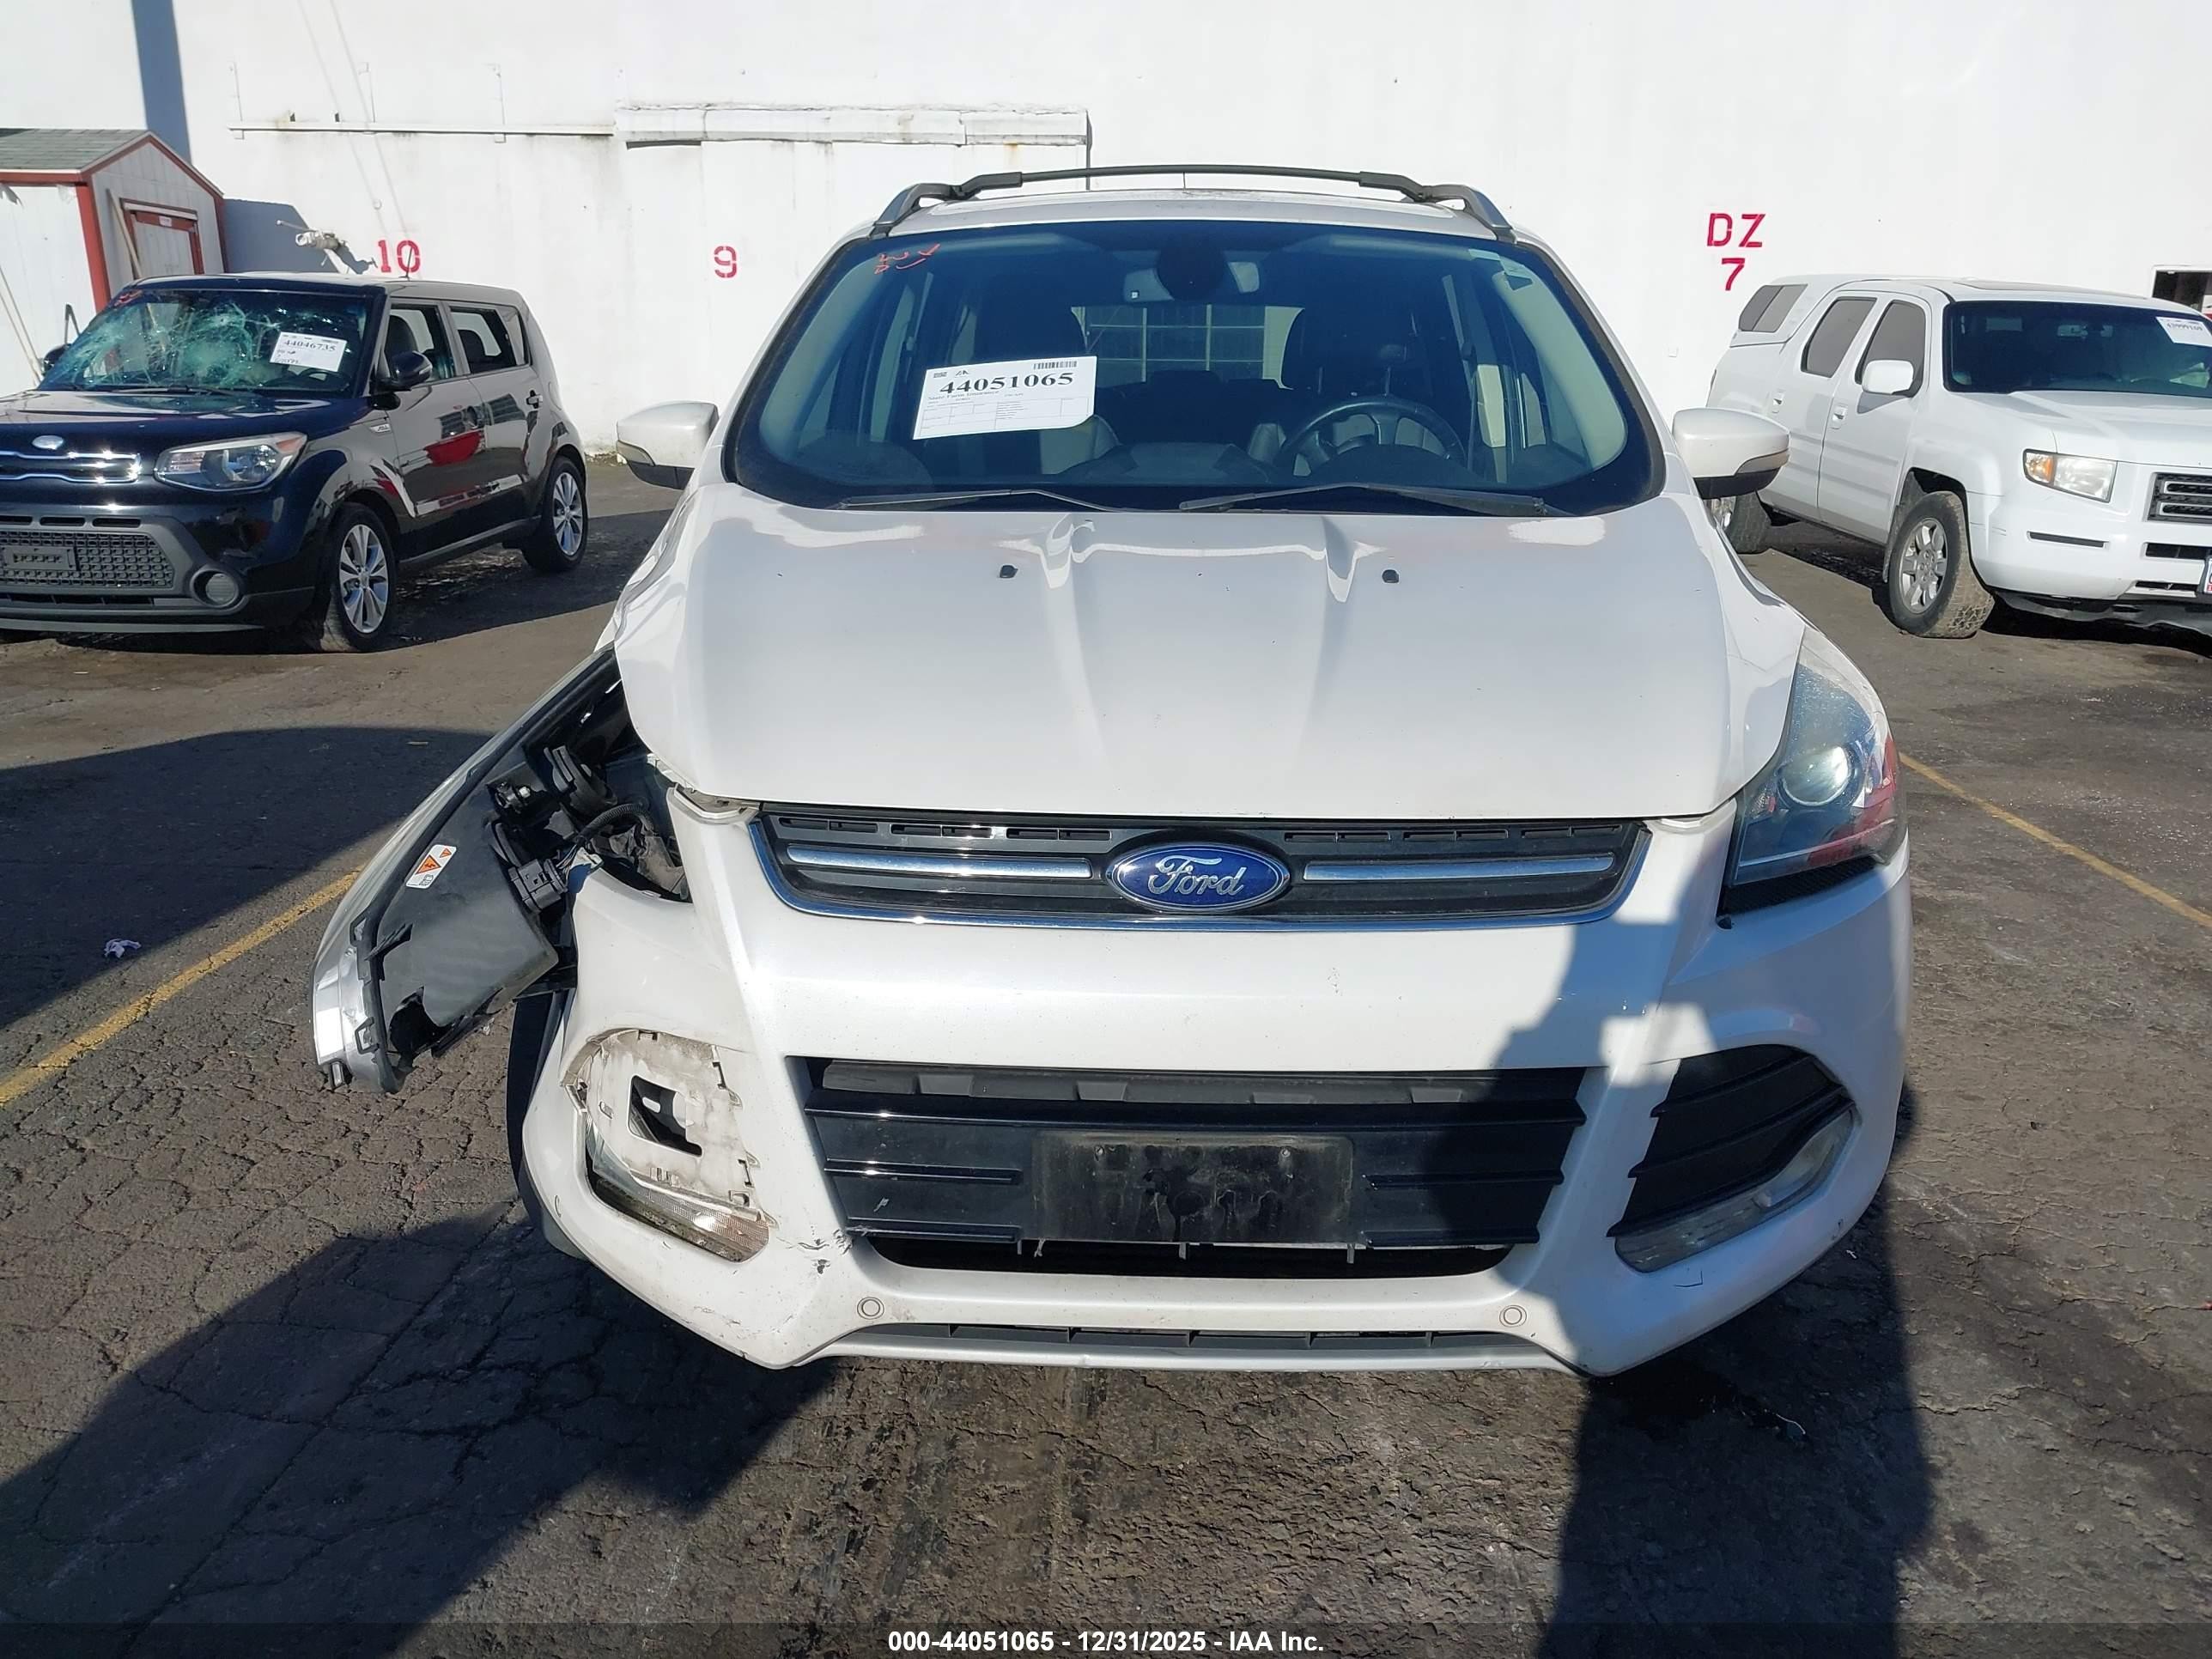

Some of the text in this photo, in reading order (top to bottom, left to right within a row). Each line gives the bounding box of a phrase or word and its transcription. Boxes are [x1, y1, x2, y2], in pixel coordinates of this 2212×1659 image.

[1706, 212, 1765, 247] DZ
[378, 240, 421, 273] 10
[714, 246, 738, 278] 9
[1722, 258, 1746, 291] 7
[940, 373, 1073, 394] 44051065
[1148, 855, 1247, 895] Ford
